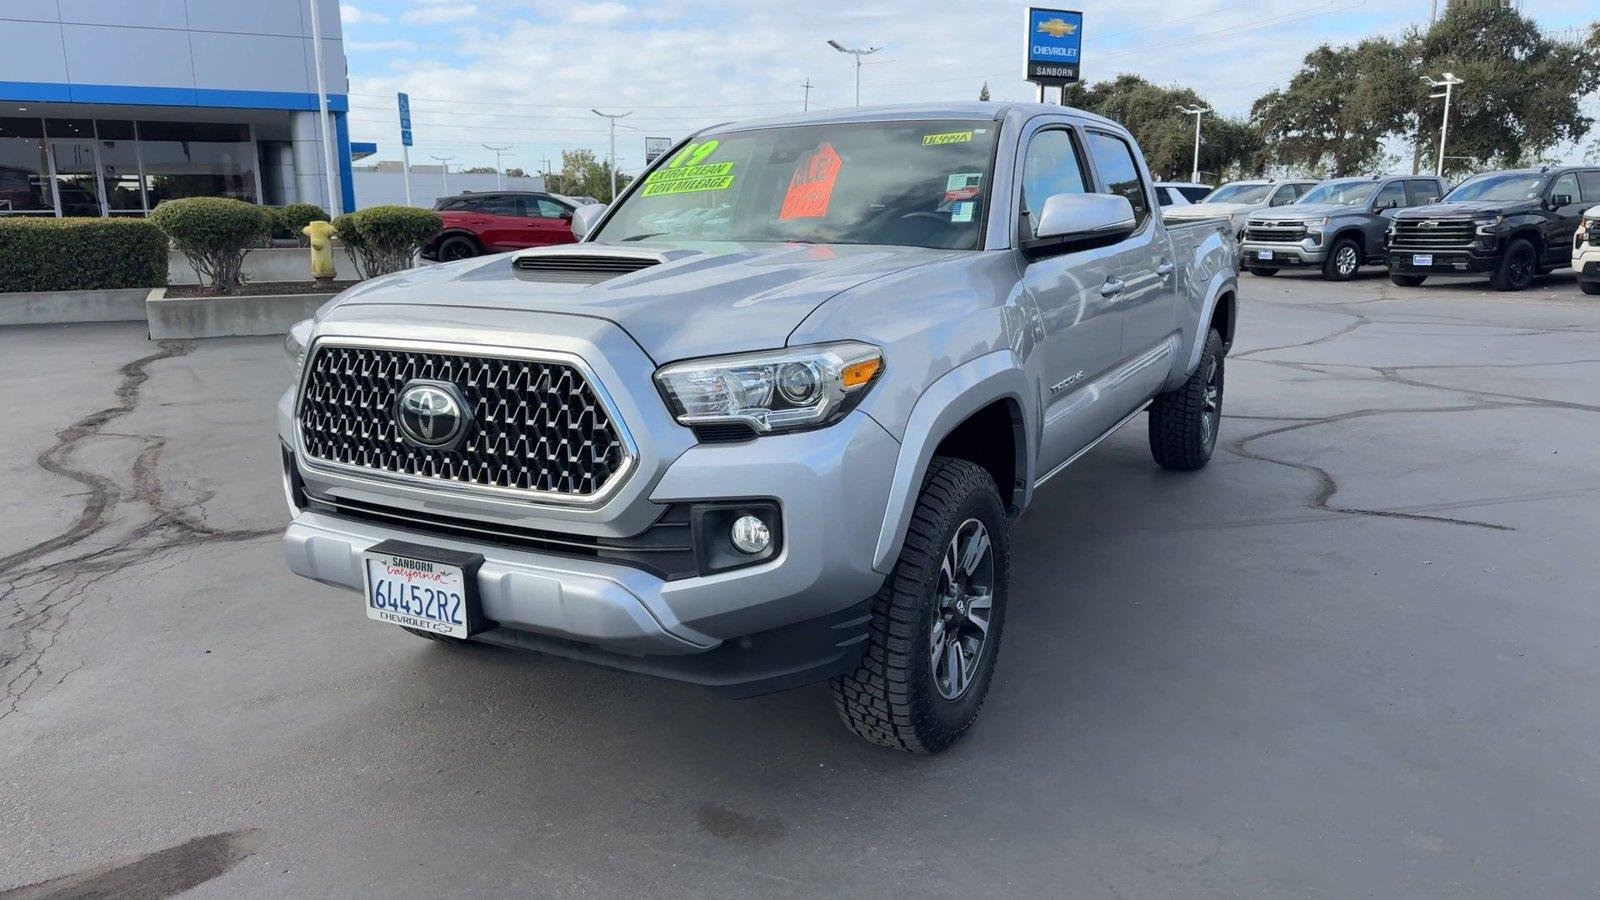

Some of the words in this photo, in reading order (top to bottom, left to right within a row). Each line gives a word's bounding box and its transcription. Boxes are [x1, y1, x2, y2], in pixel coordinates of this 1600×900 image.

[1033, 46, 1078, 57] CHEVROLET
[1036, 66, 1073, 77] SANBORN
[672, 176, 730, 192] MILEAGE
[392, 557, 433, 573] SANBORN
[375, 580, 463, 625] 64452R2
[380, 612, 431, 629] CHEVROLET
